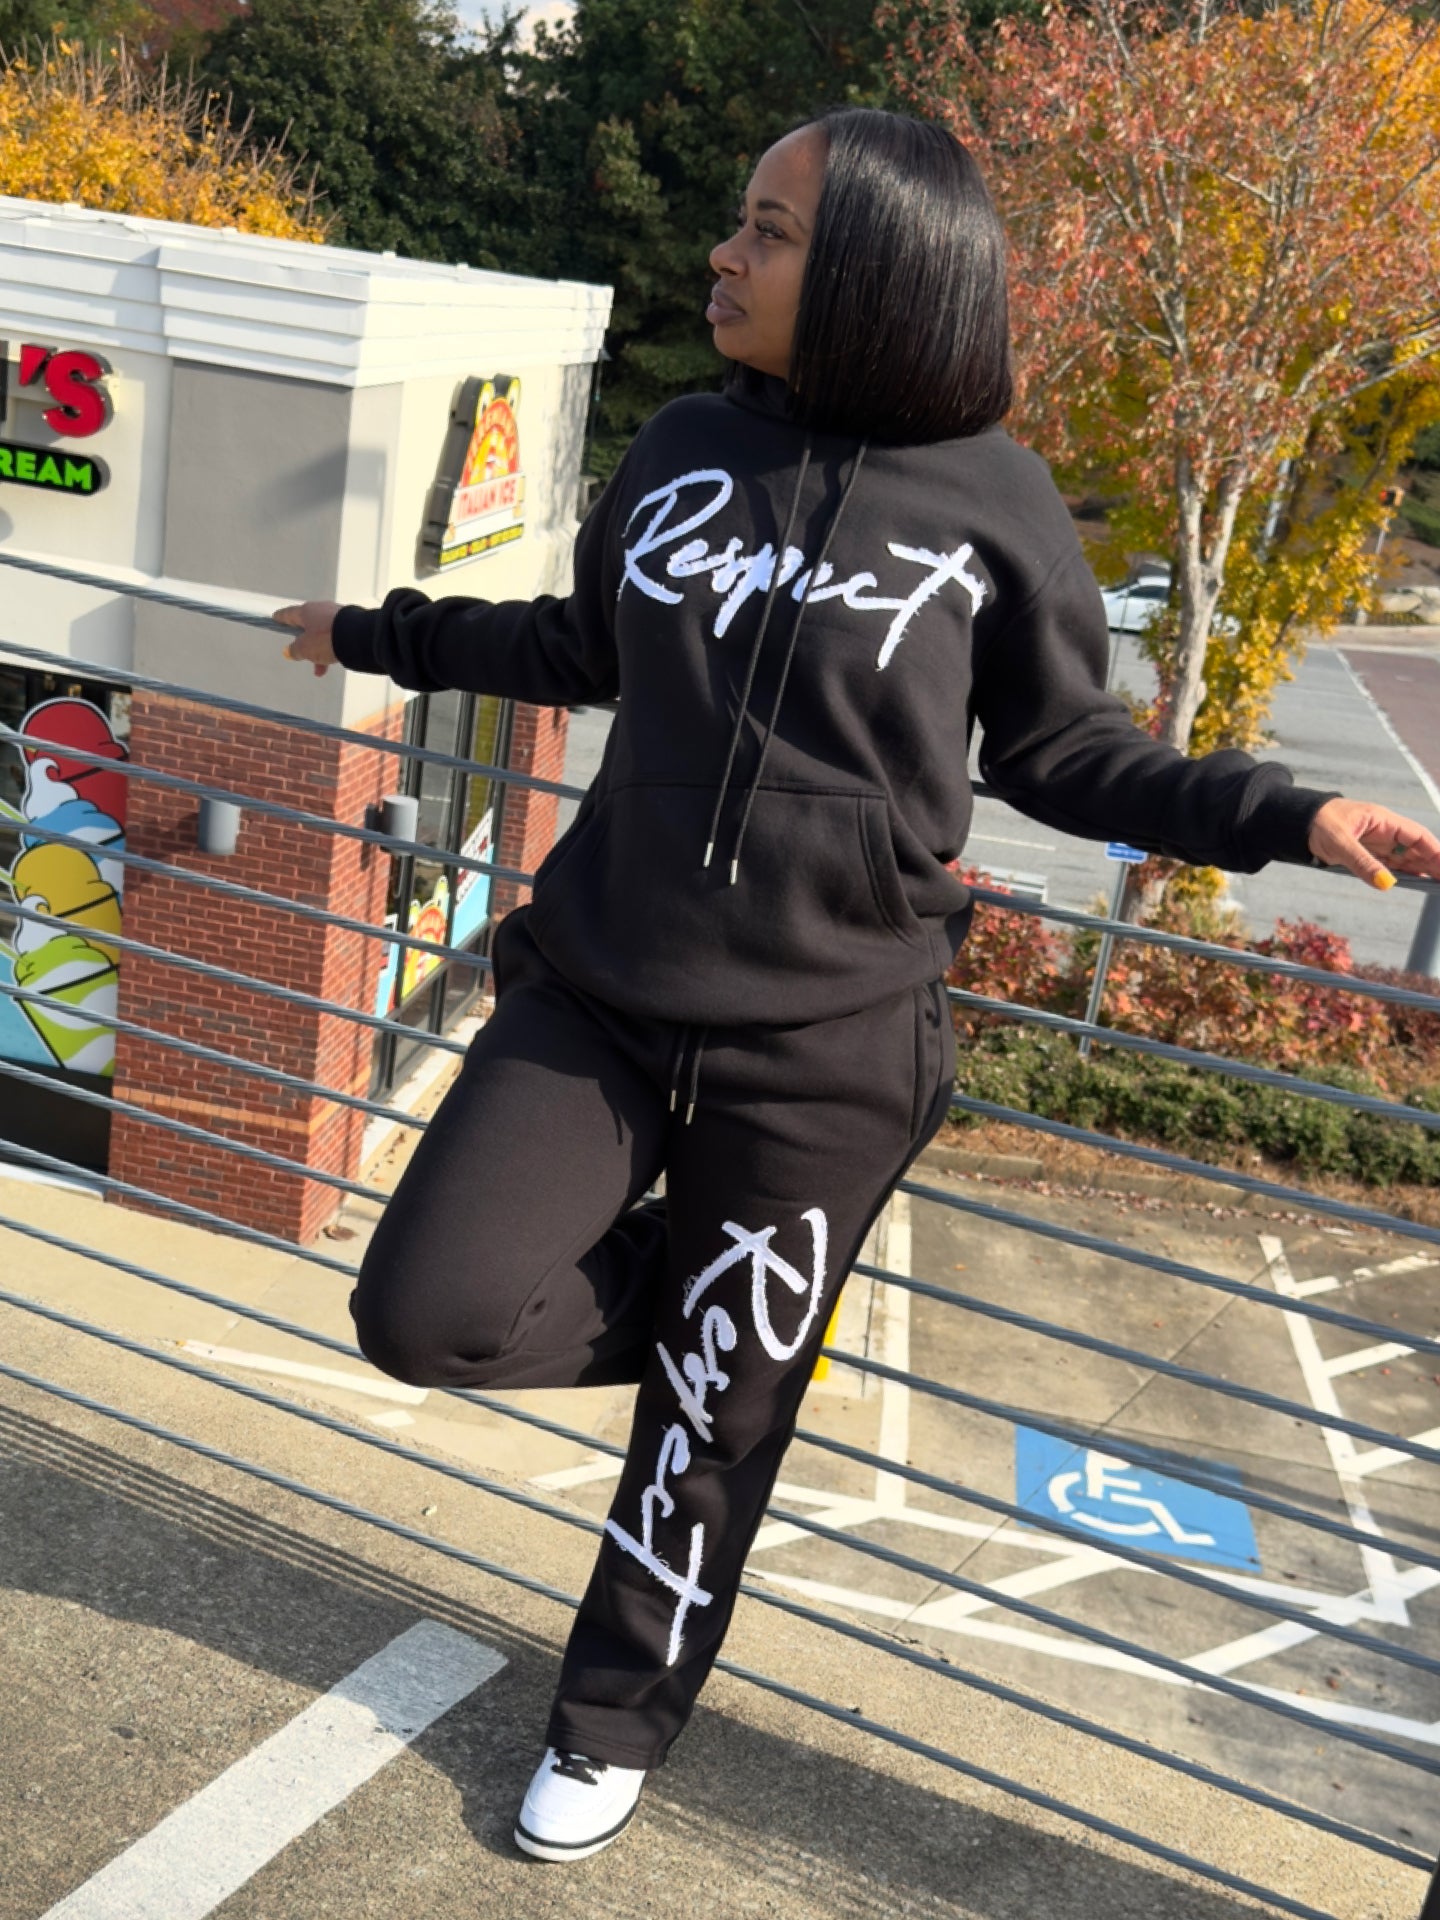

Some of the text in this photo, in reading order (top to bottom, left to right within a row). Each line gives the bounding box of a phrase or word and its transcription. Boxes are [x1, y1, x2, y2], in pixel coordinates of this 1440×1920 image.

[0, 341, 106, 438] 'S
[617, 468, 988, 671] Respect
[605, 1208, 828, 1667] Respect
